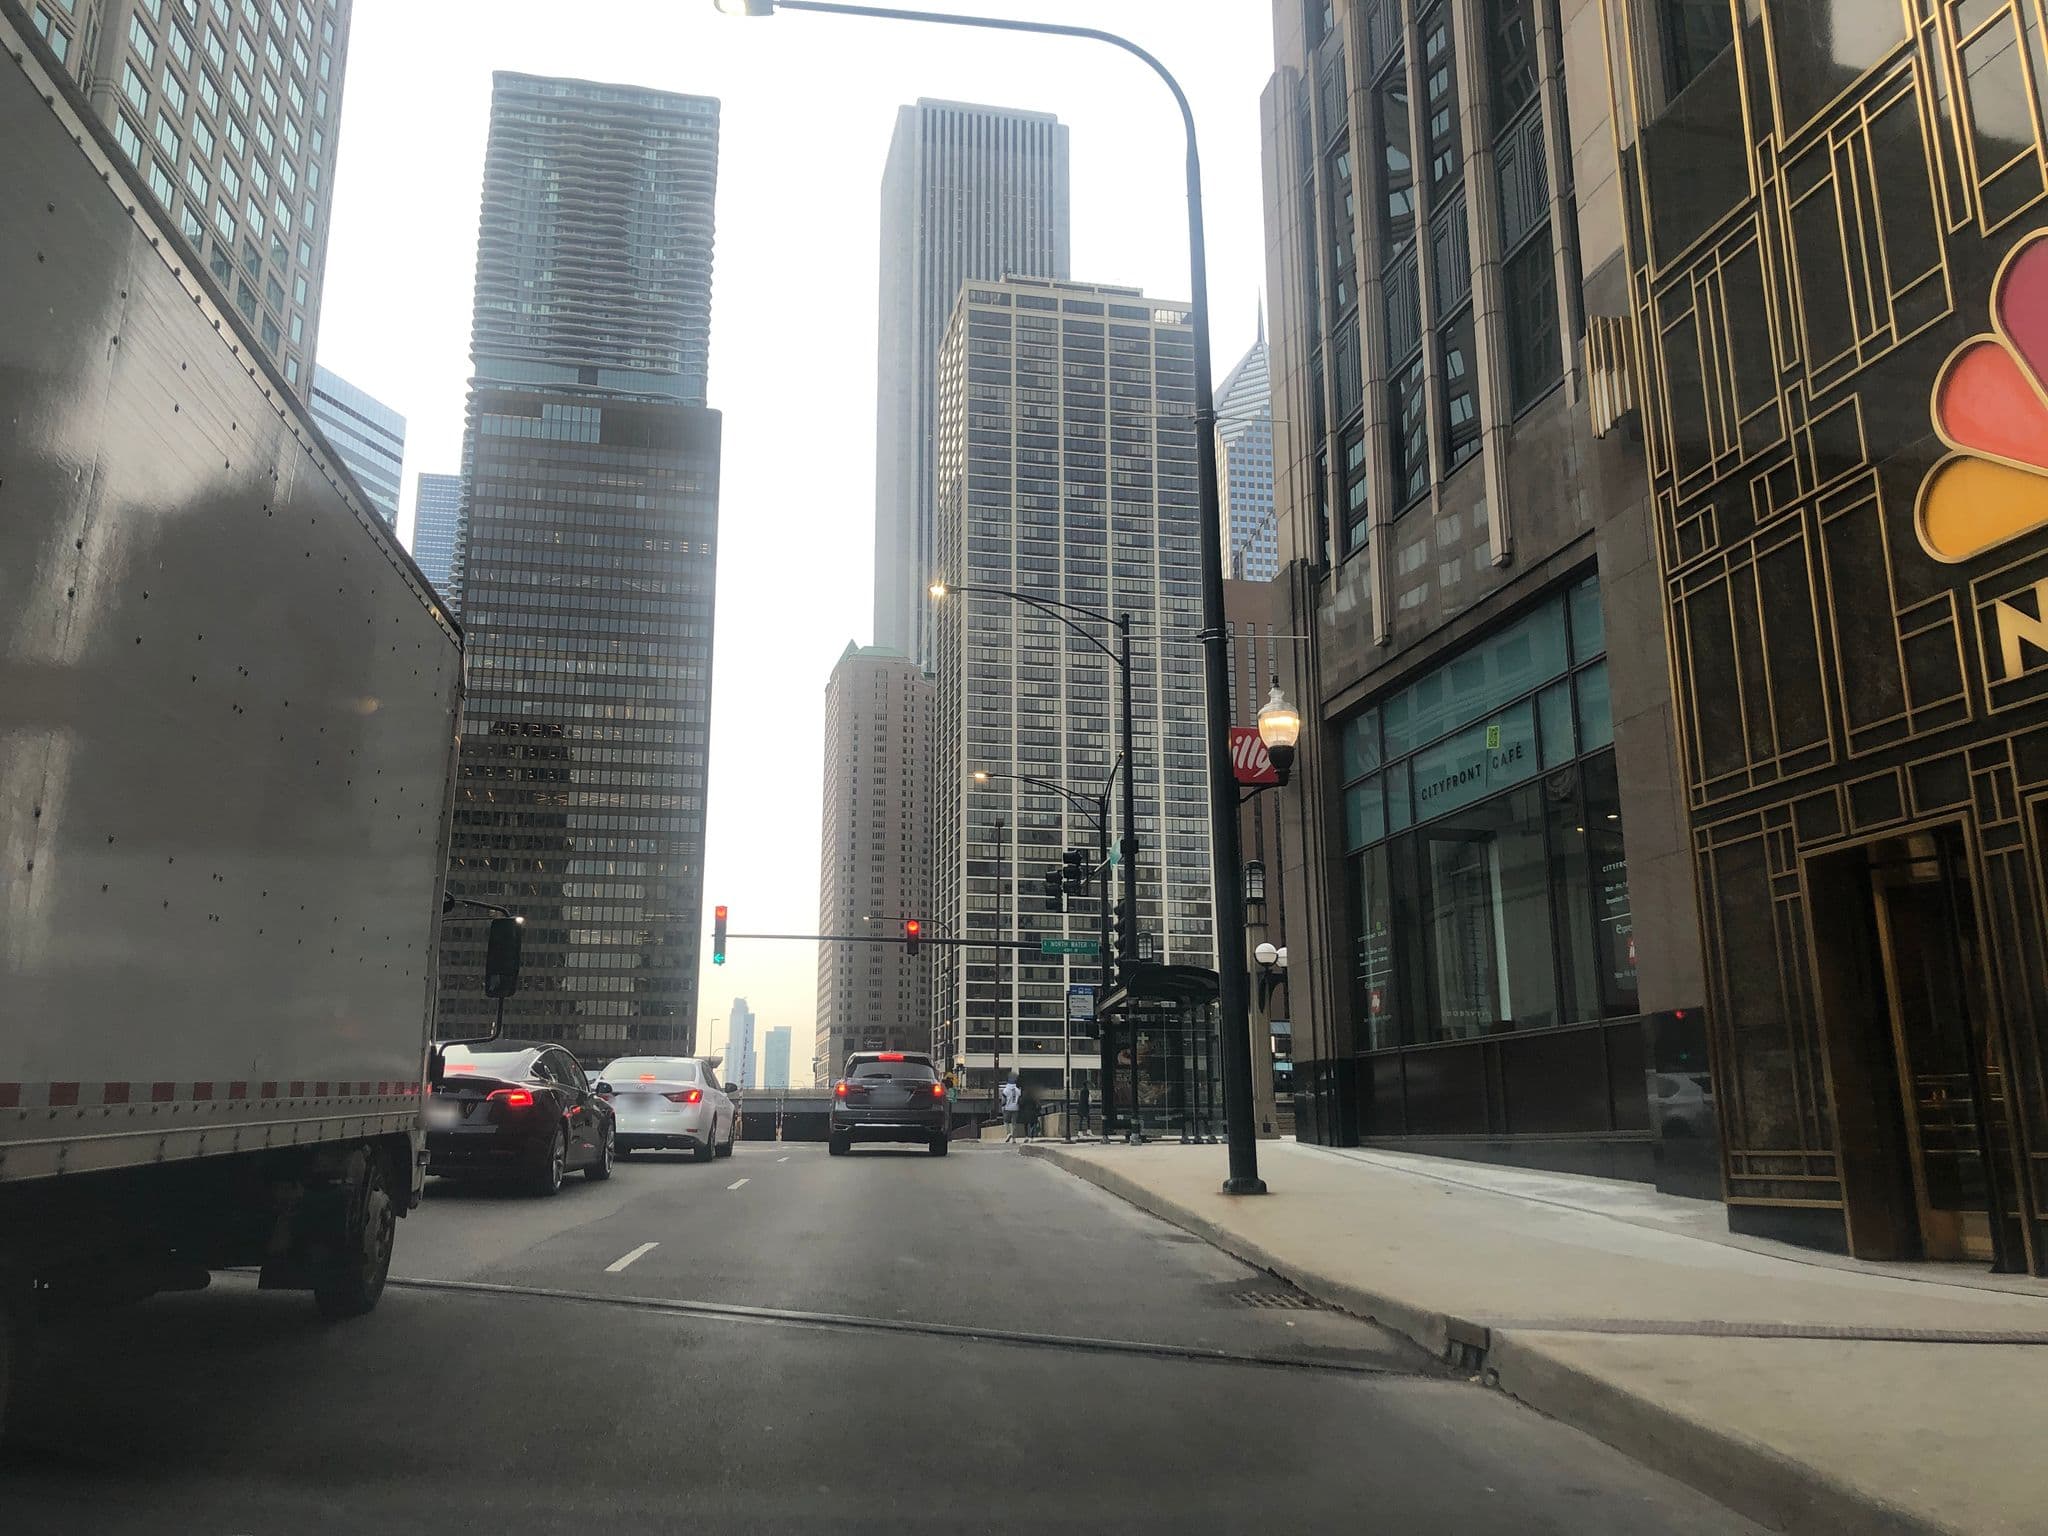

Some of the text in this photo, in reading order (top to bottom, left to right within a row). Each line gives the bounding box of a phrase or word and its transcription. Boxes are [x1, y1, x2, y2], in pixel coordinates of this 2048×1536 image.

[1232, 735, 1271, 778] illy
[1421, 741, 1523, 801] CITYFRONT CAFÉ
